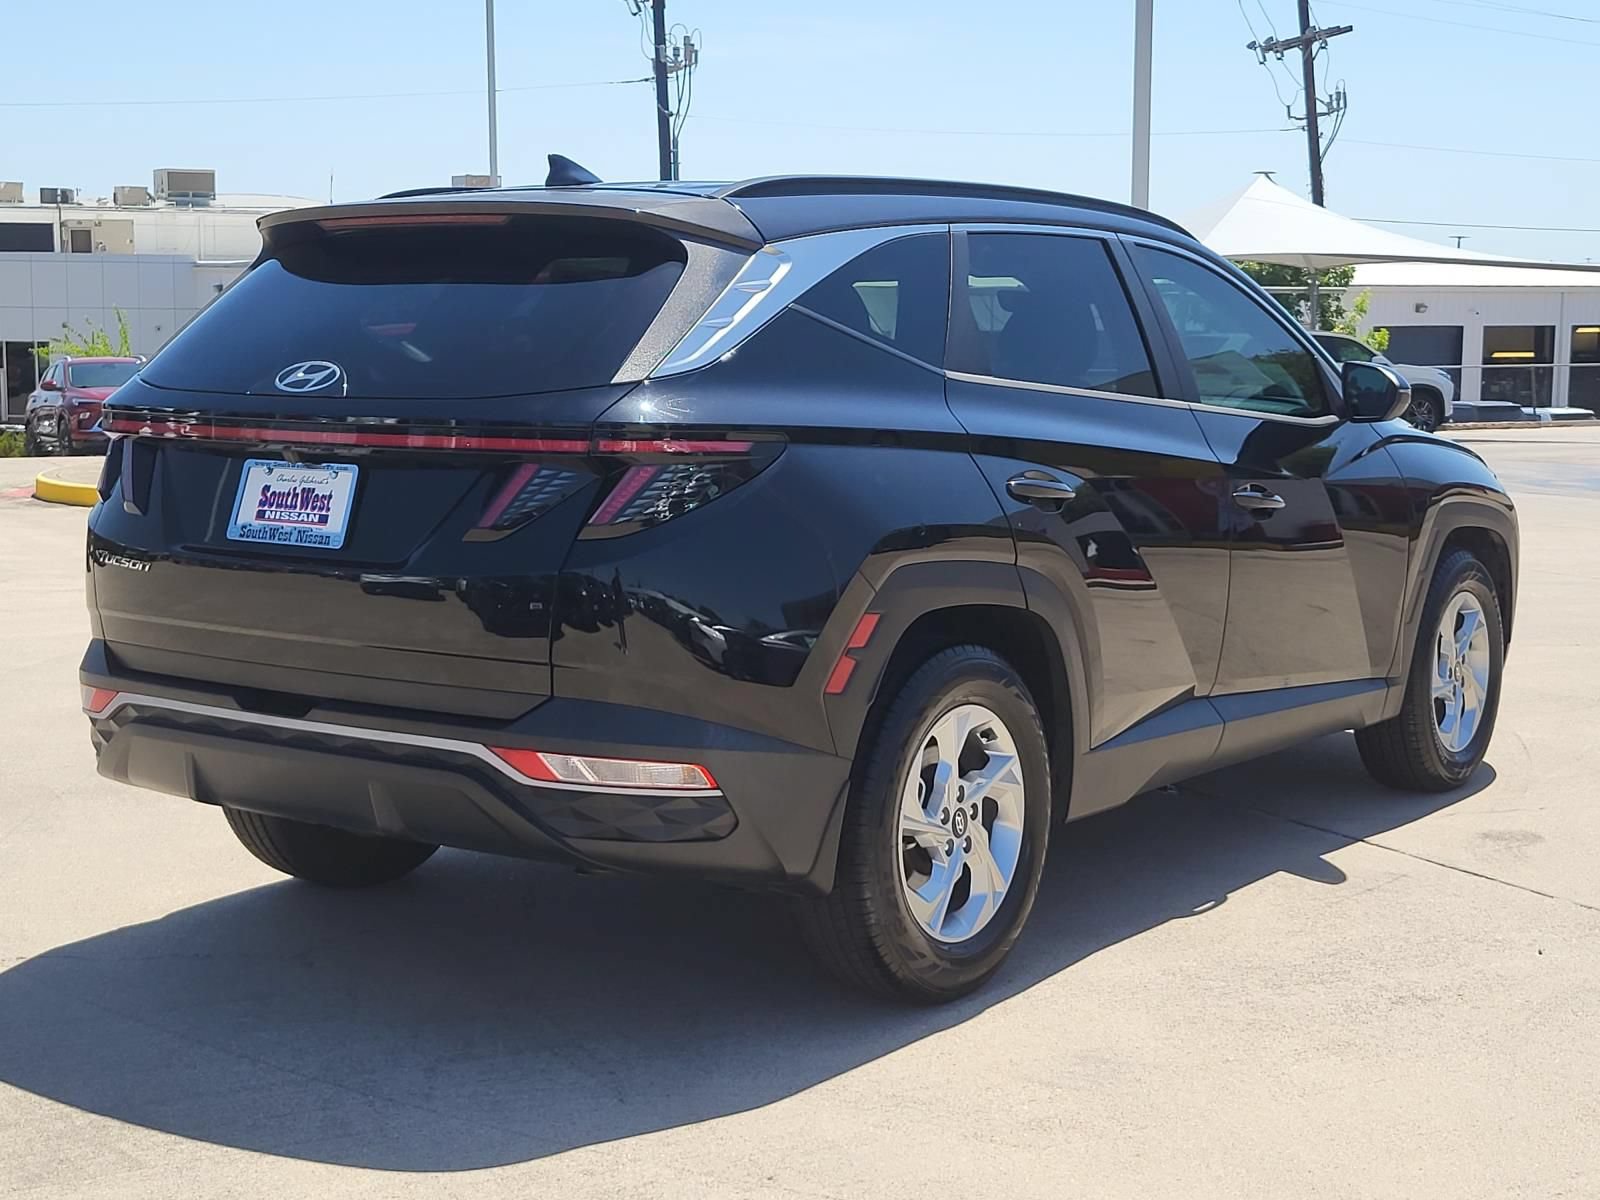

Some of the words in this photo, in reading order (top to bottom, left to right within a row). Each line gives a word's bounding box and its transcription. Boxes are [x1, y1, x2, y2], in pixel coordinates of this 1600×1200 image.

[257, 484, 333, 513] SouthWest
[264, 510, 320, 522] NISSAN
[239, 523, 293, 543] SouthWest
[295, 527, 331, 546] Nissan
